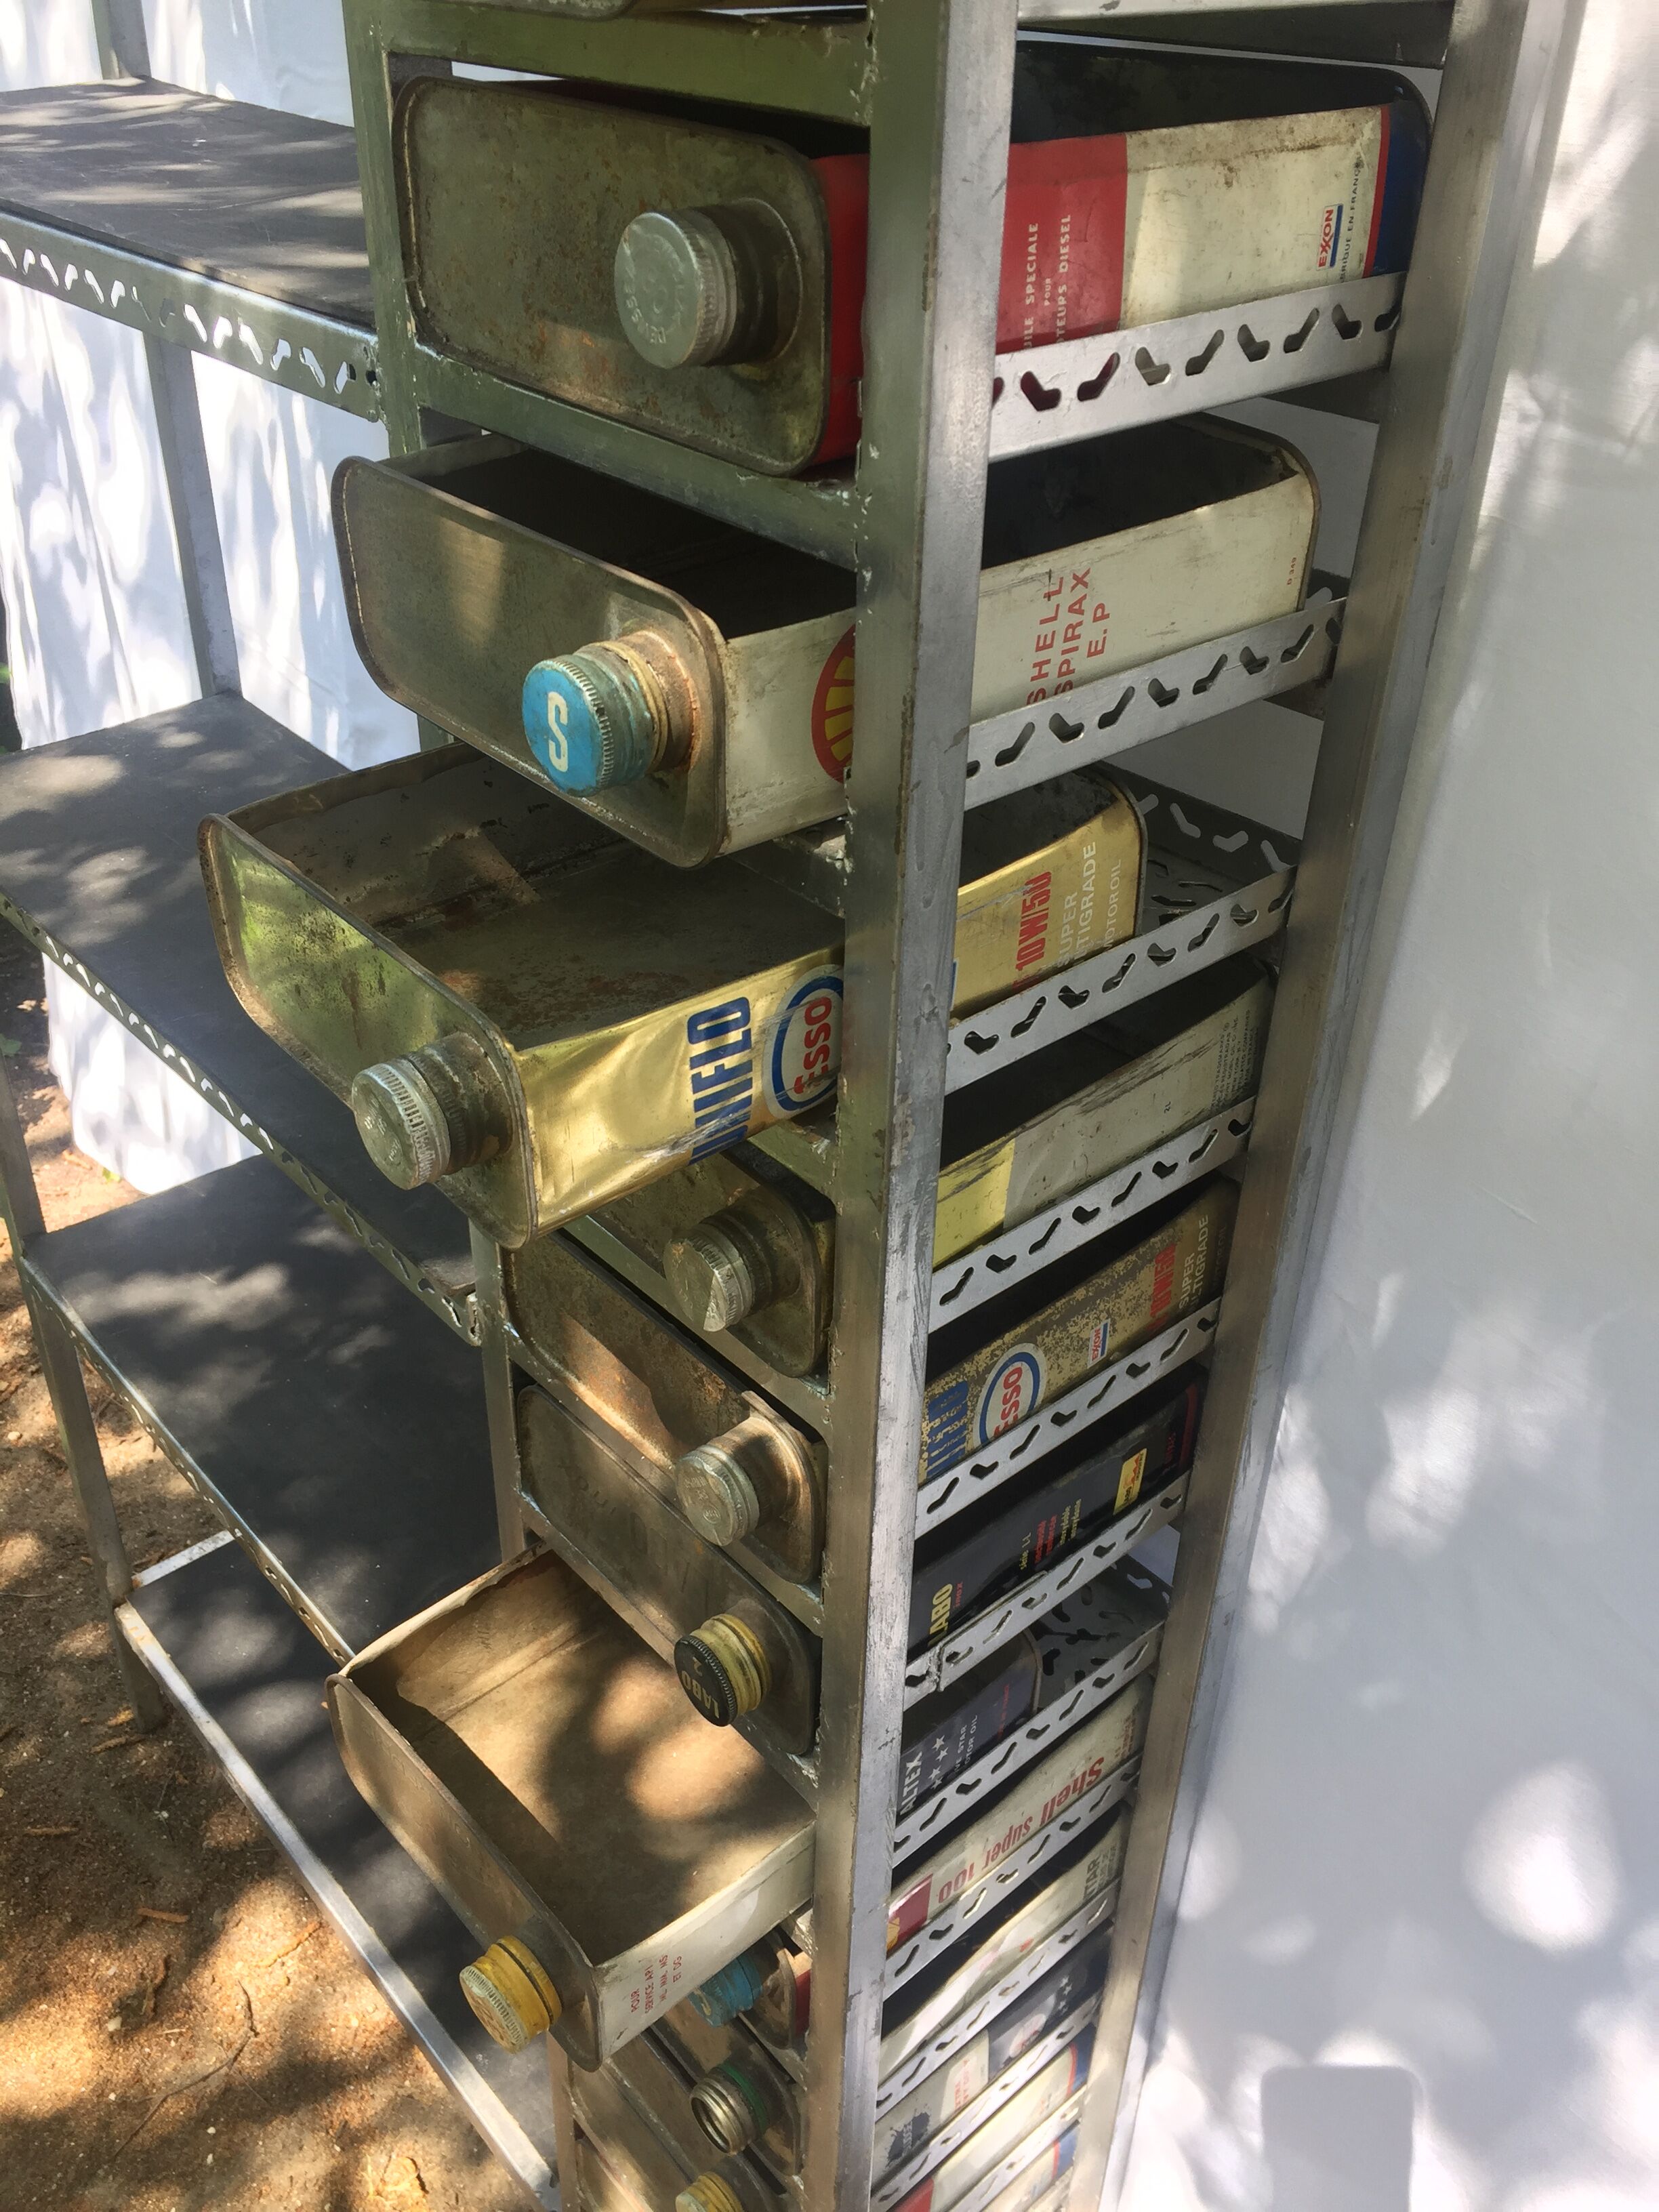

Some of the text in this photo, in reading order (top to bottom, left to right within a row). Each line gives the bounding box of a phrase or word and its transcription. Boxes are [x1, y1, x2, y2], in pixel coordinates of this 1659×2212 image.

[1059, 214, 1071, 273] DIESEL
[1317, 209, 1334, 268] EXXON
[1347, 216, 1355, 232] EN
[1025, 223, 1039, 305] SPECIALE
[1026, 576, 1064, 705] SHELL
[1053, 567, 1091, 696] SPIRAX
[548, 691, 569, 773] S
[1057, 891, 1078, 968] SUPER
[687, 996, 753, 1166] UNIFLO
[1179, 1252, 1195, 1310] SUPER
[957, 1724, 968, 1754] STAR
[970, 1715, 978, 1735] OIL
[899, 1751, 923, 1816] ALTEX
[938, 1862, 975, 1904] 100
[631, 1988, 640, 2013] POUR
[644, 1965, 654, 2014] SERVICE API
